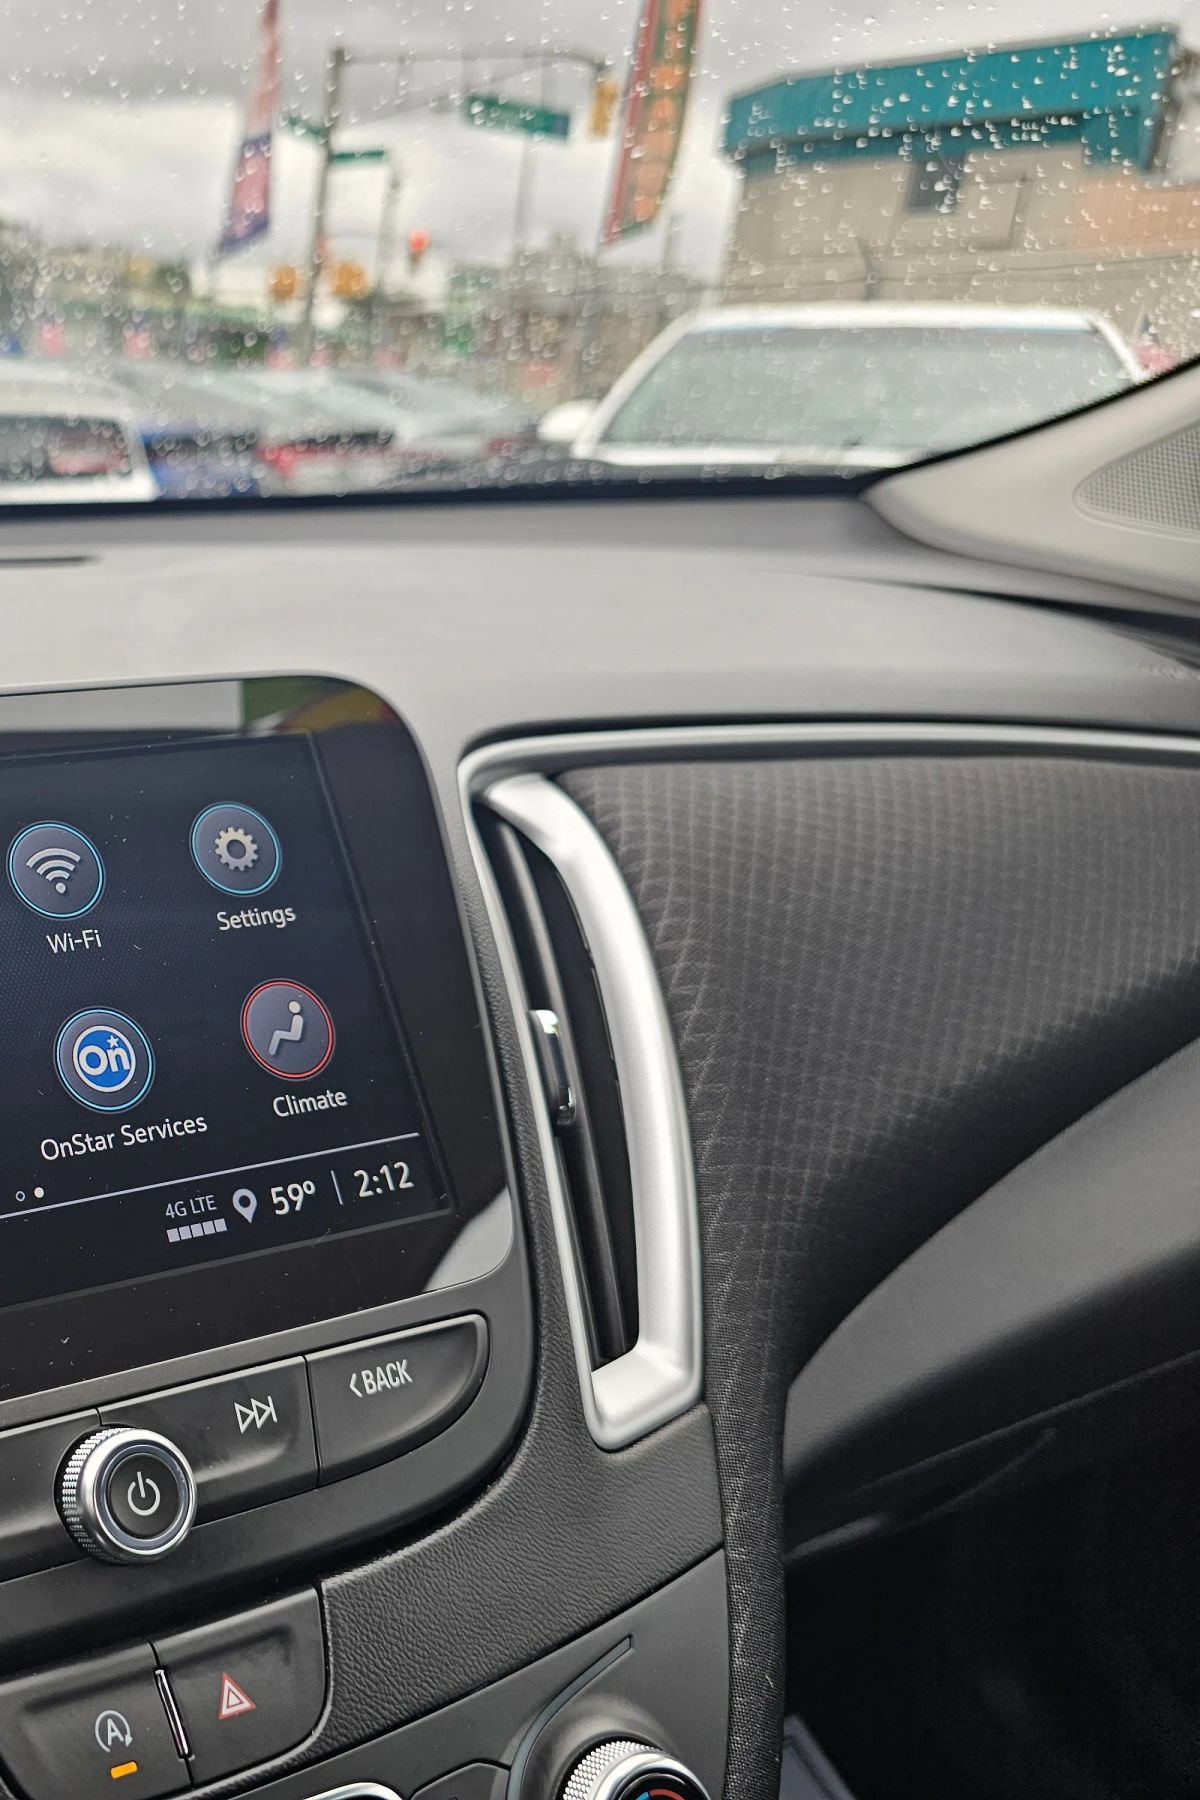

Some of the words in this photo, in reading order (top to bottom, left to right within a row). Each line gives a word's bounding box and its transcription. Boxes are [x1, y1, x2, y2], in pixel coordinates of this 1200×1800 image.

[216, 906, 296, 931] Settings
[46, 929, 102, 954] Wi-Fi
[79, 1045, 131, 1076] On
[272, 1088, 348, 1118] Climate
[40, 1131, 115, 1161] OnStar
[121, 1114, 208, 1147] Services
[353, 1161, 415, 1198] 2:12
[165, 1201, 187, 1219] 4G
[191, 1194, 217, 1214] LTE
